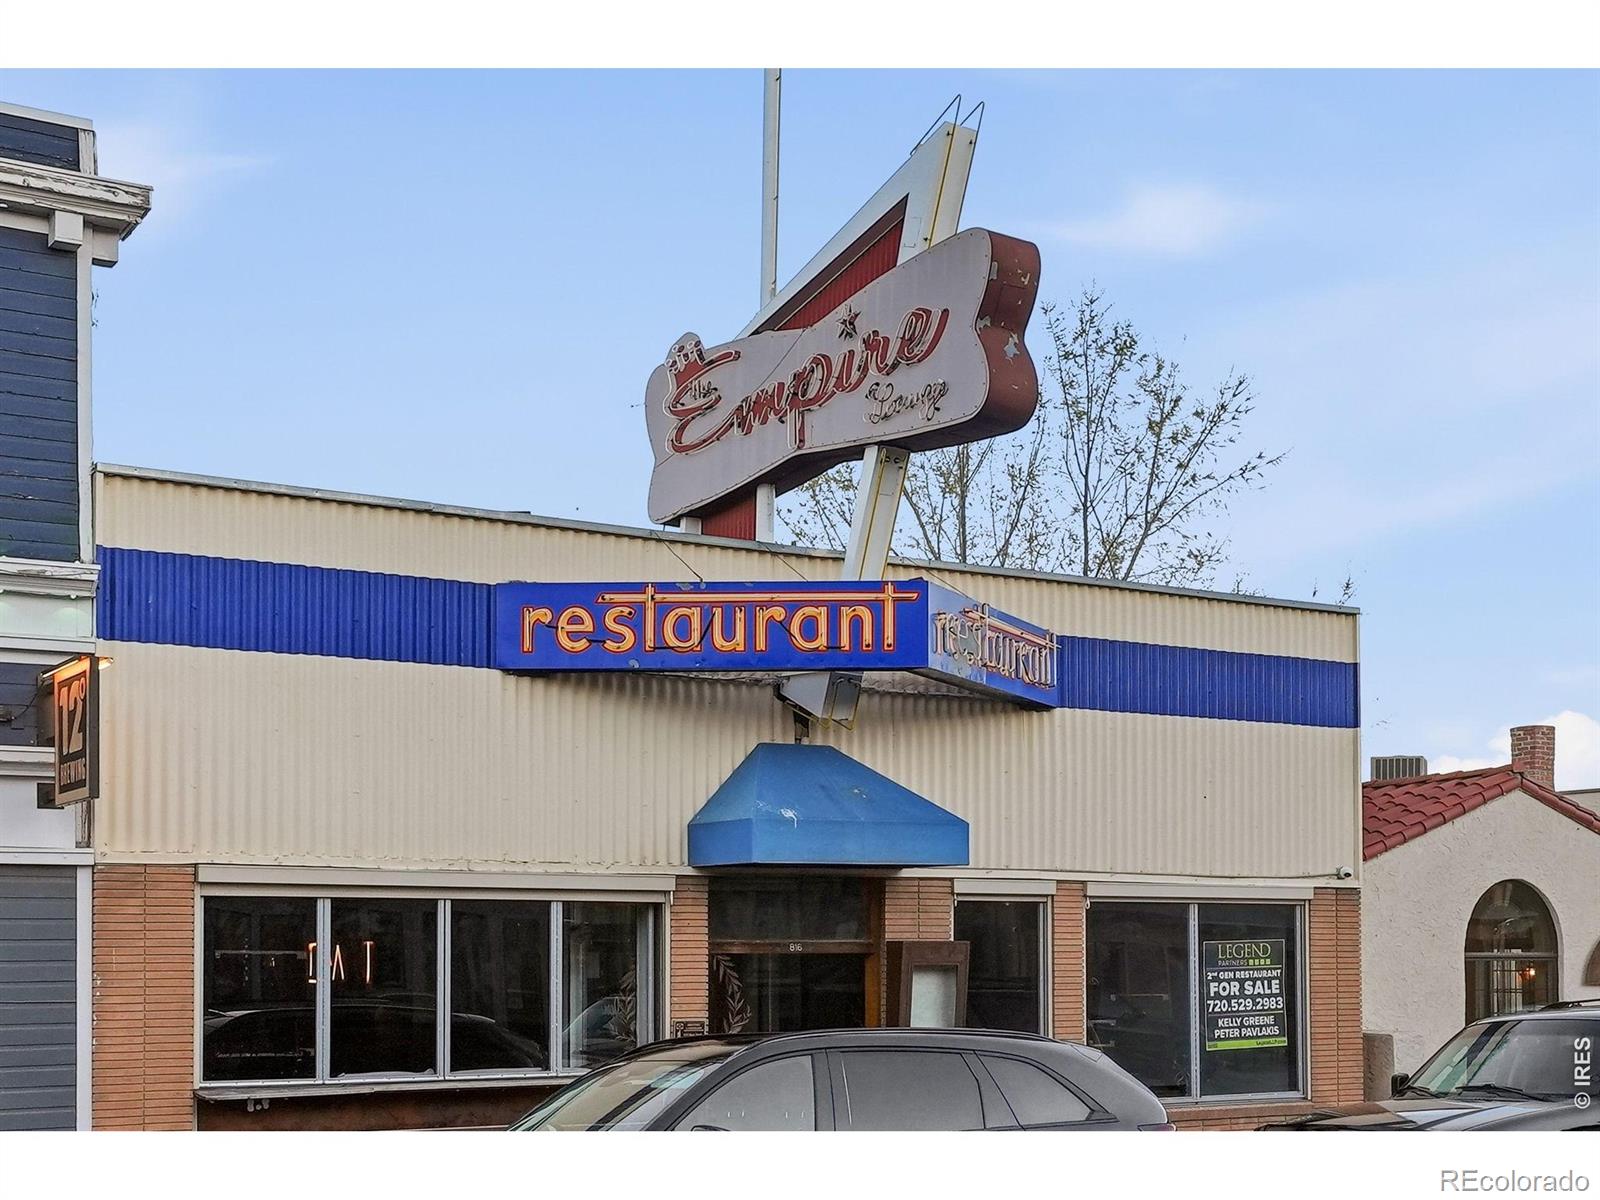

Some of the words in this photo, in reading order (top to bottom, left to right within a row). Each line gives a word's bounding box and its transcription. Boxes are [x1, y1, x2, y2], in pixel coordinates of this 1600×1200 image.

[663, 307, 950, 455] Empire
[689, 378, 718, 400] The
[863, 379, 949, 424] Lounge
[520, 582, 921, 654] restaurant
[931, 603, 1062, 690] restaurant
[789, 943, 803, 951] 816
[1218, 943, 1271, 959] LEGEND
[1218, 971, 1235, 979] GEN
[1235, 969, 1282, 979] RESTAURANT
[1209, 981, 1240, 997] FOR
[1244, 979, 1281, 995] SALE
[1207, 997, 1284, 1013] 720.529.2983
[1218, 1017, 1242, 1028] KELLY
[1242, 1015, 1275, 1026] GREENE
[1214, 1028, 1240, 1039] PETER
[1241, 1025, 1280, 1038] PAVLAKIS
